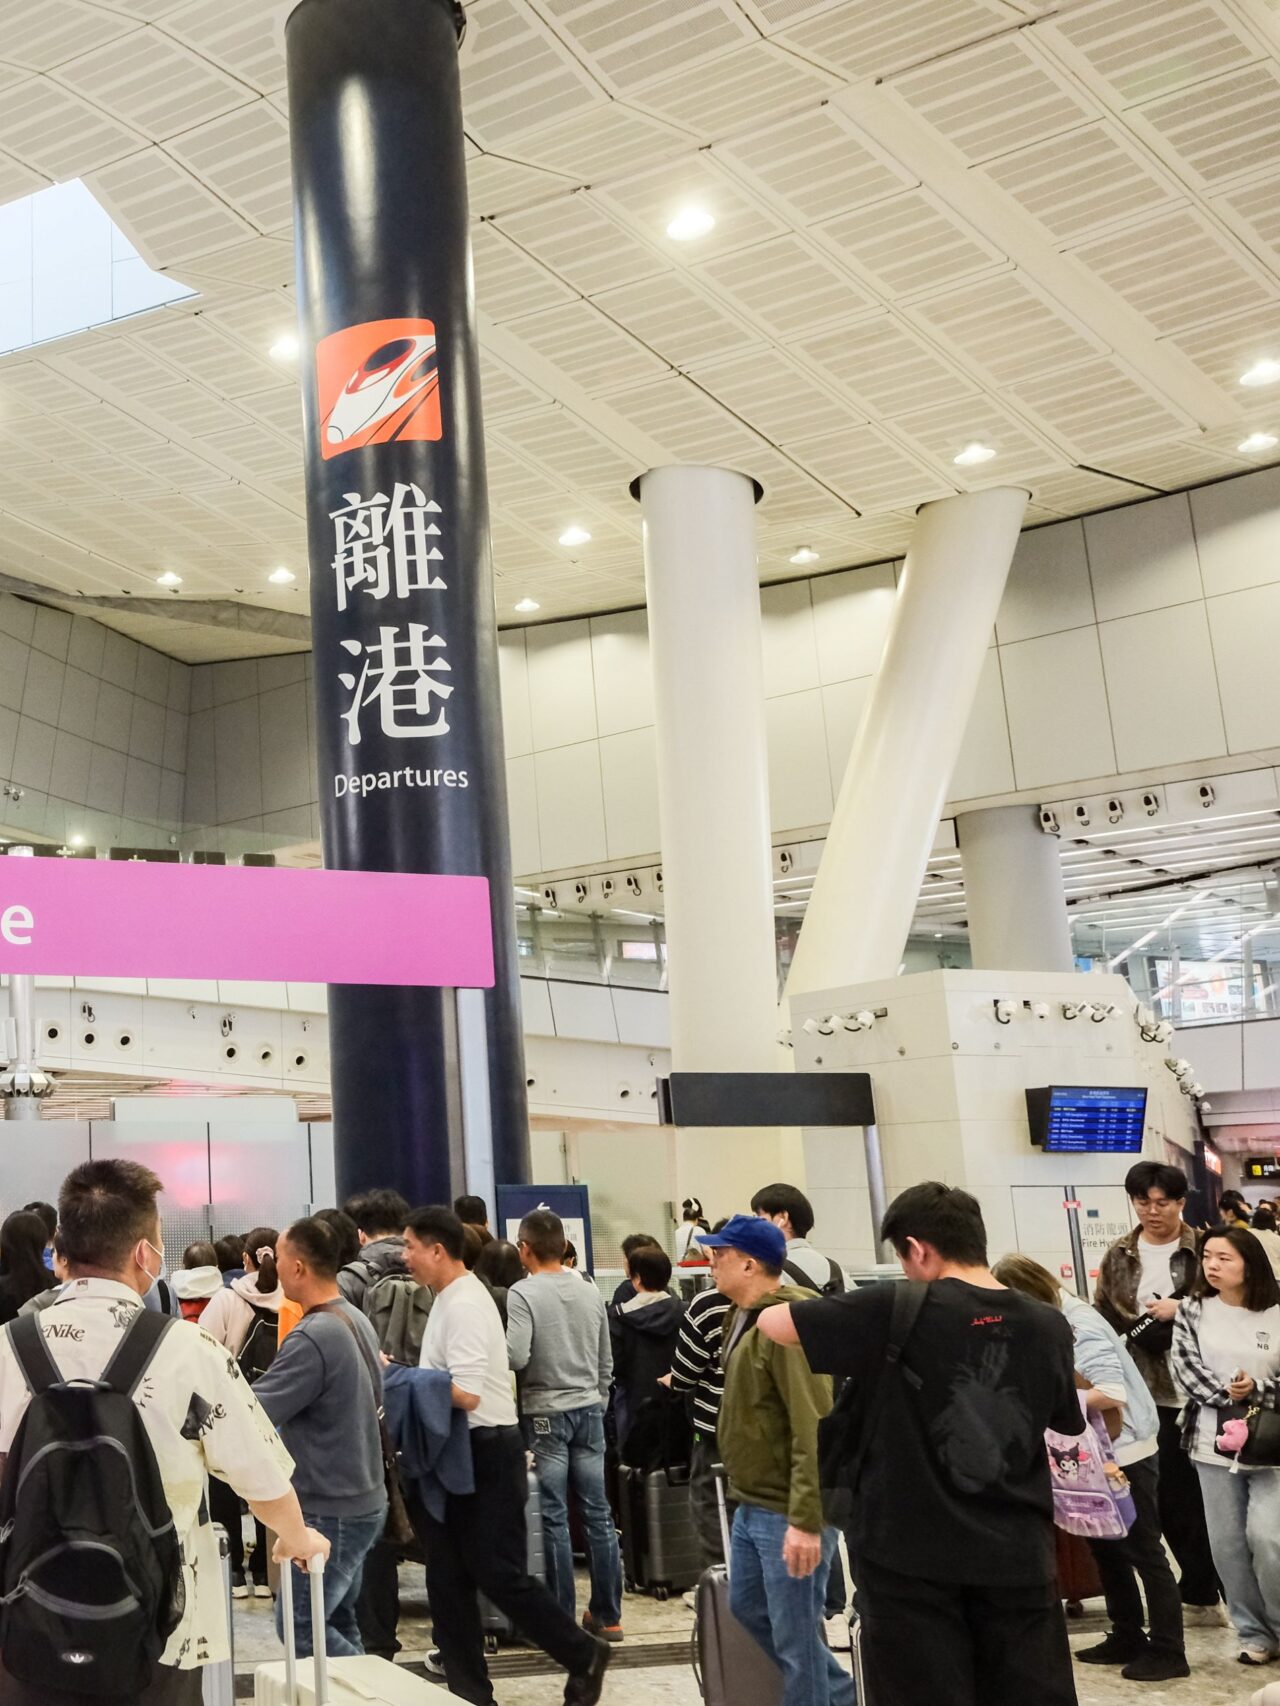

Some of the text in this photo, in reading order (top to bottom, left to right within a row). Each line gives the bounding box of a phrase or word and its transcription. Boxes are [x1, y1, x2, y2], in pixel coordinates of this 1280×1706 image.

[328, 482, 454, 746] 離港
[334, 764, 469, 798] Departures
[1082, 1238, 1098, 1248] Fire
[41, 1324, 85, 1342] Nike
